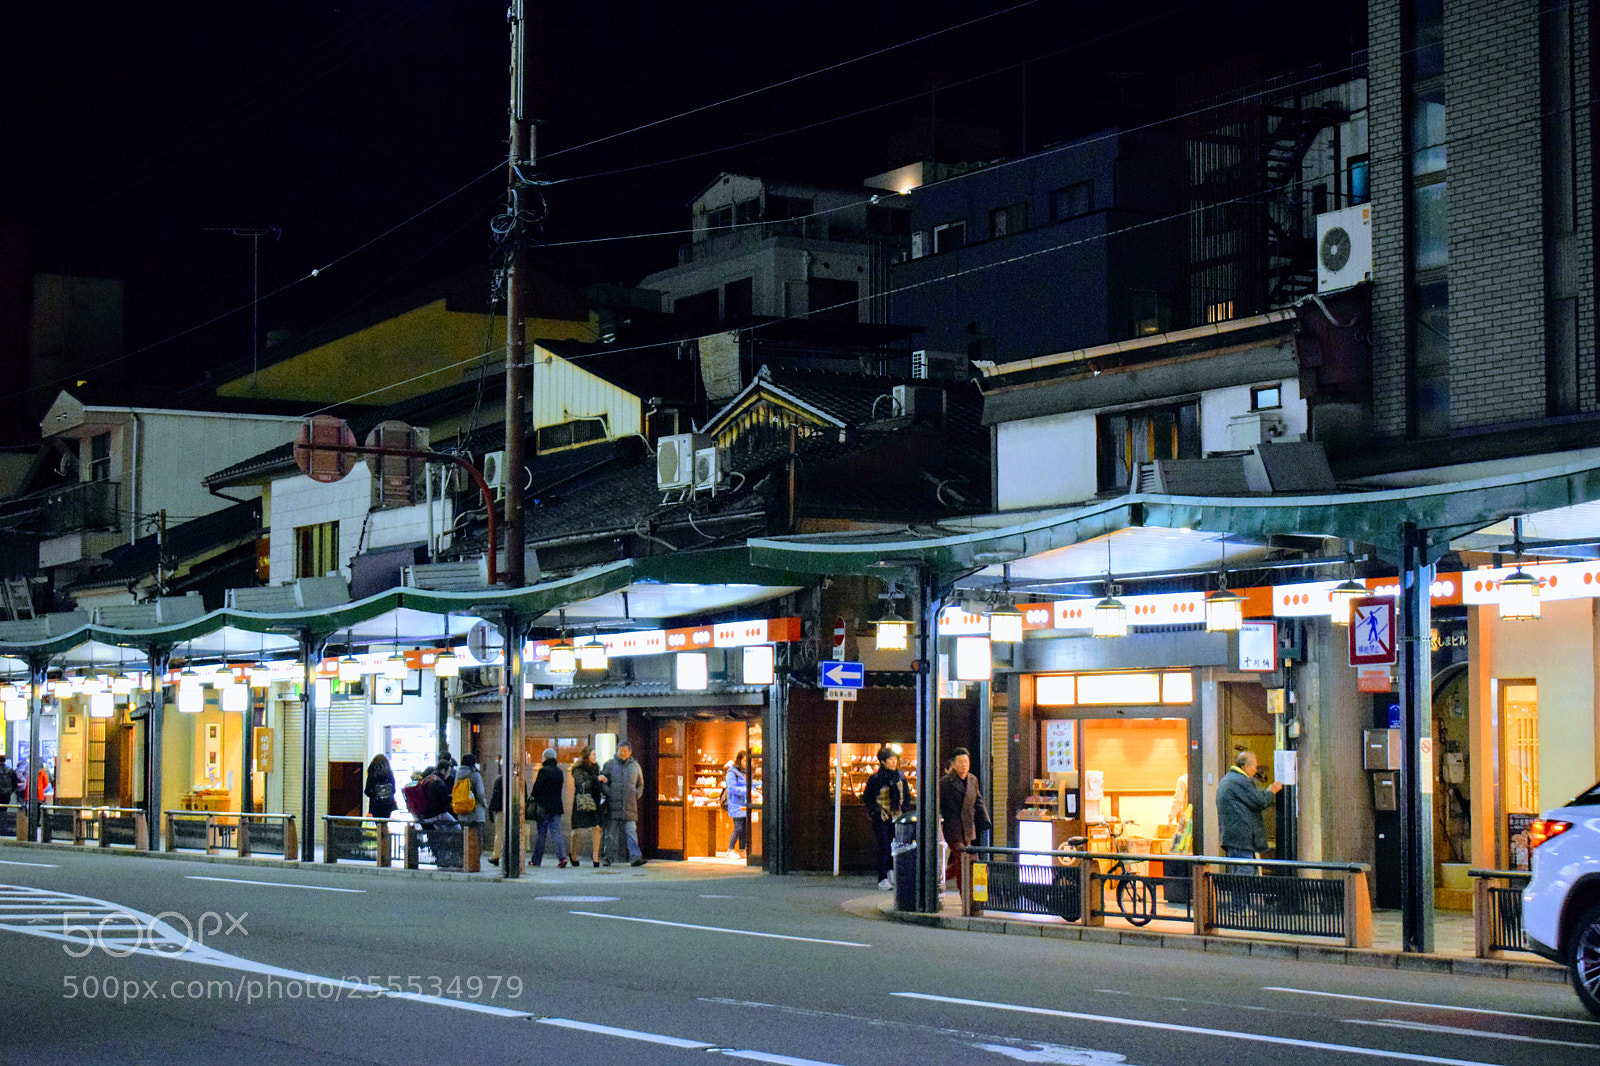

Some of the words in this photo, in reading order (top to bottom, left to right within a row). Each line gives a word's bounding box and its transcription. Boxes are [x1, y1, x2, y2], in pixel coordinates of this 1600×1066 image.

[1431, 635, 1468, 647] くしまビル
